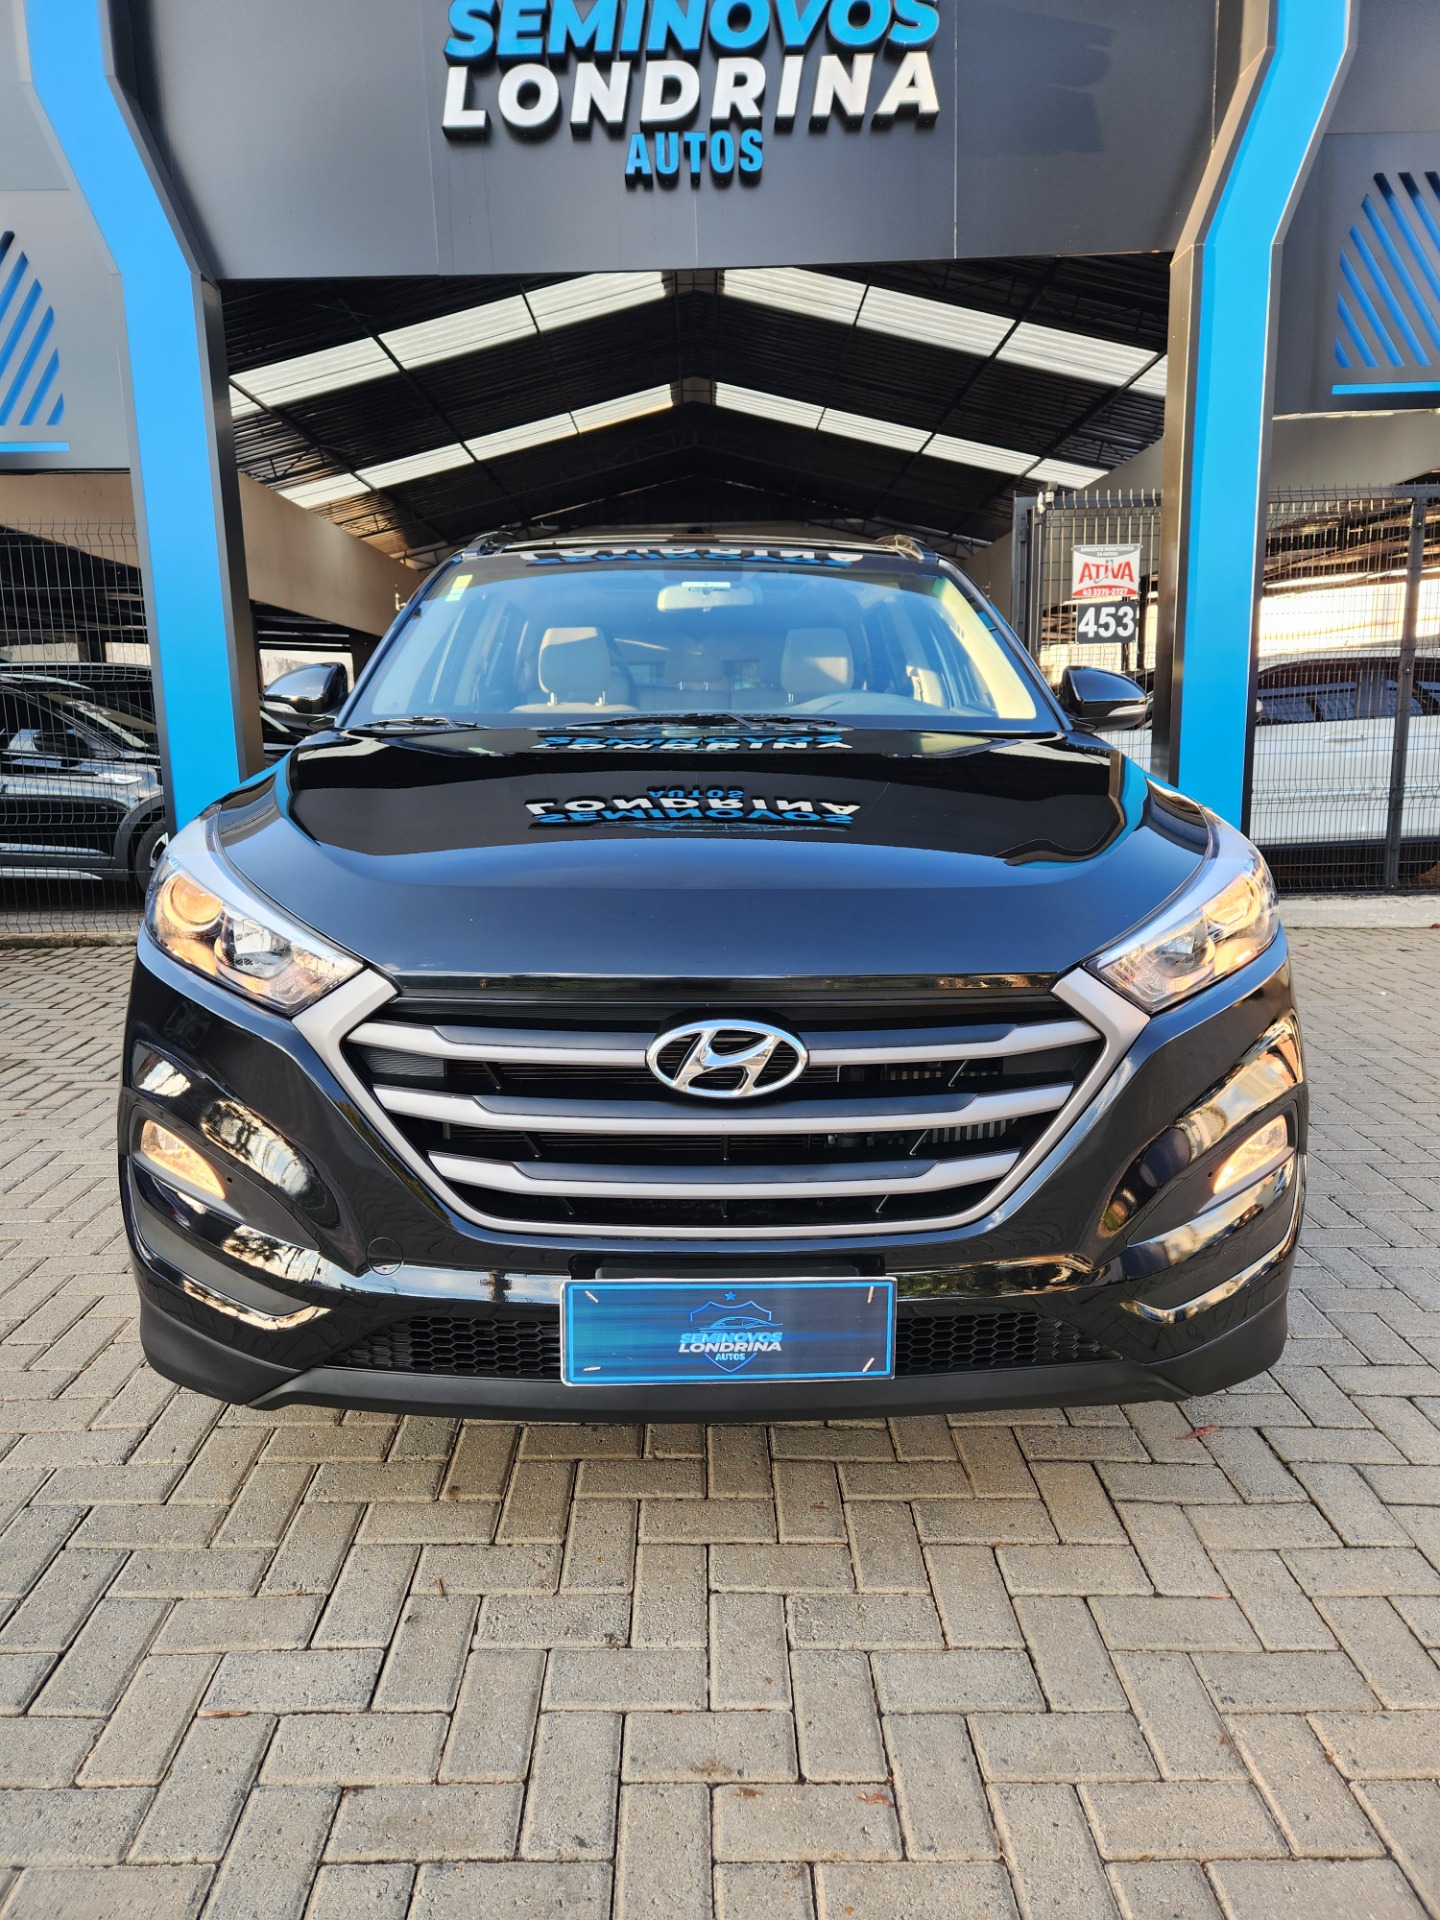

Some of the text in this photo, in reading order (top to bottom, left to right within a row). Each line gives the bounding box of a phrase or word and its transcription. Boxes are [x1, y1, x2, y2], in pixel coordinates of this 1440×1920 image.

[443, 0, 940, 59] SEMINOVOS
[442, 51, 941, 130] LONDRINA
[625, 130, 764, 180] AUTOS
[1078, 560, 1135, 584] ATIVA
[1078, 605, 1135, 638] 453
[678, 1341, 782, 1353] LONDRINA
[679, 1331, 783, 1344] SEMINOVOS
[714, 1353, 746, 1361] AUTOS
